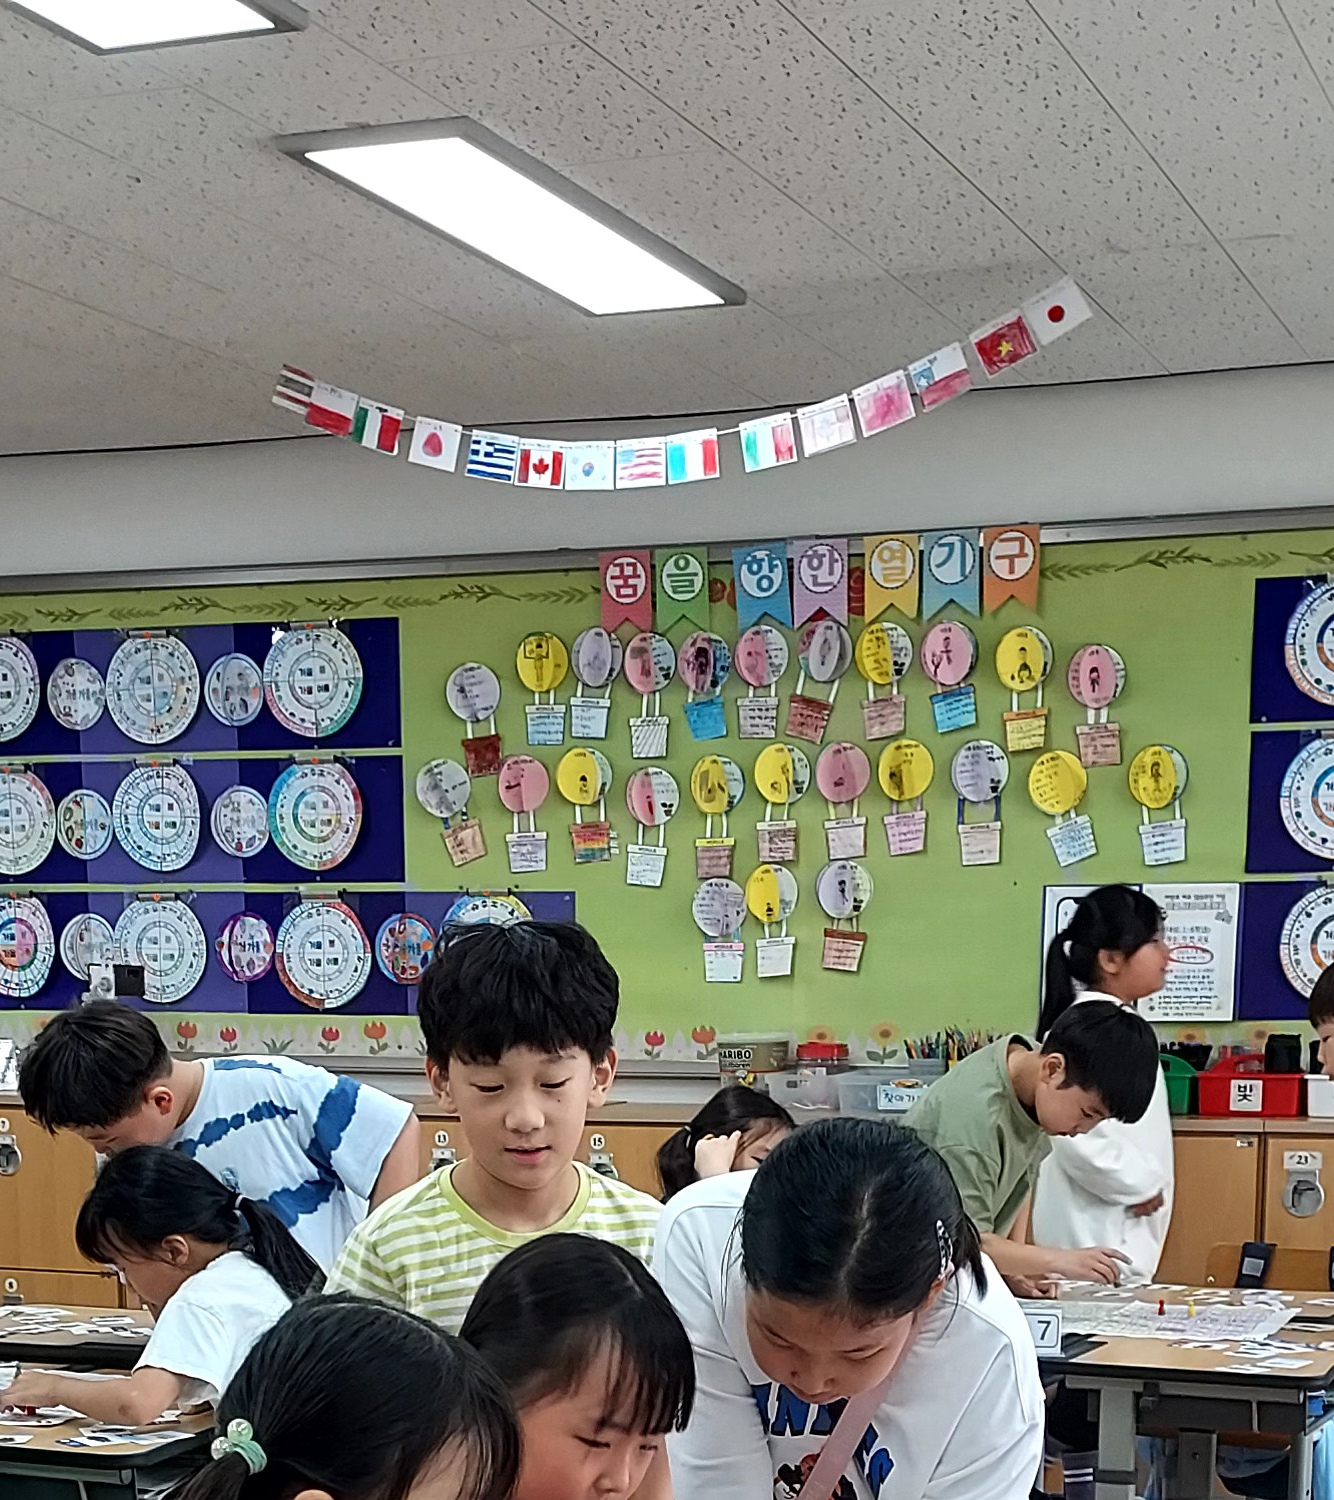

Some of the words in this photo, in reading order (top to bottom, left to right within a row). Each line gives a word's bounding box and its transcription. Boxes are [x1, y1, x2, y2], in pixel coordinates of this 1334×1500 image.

[610, 555, 700, 598] 꿈을
[746, 543, 837, 594] 향한
[878, 535, 1029, 586] 열기구
[884, 1091, 920, 1104] 찾아가
[1237, 1084, 1253, 1103] 빛
[437, 1134, 447, 1143] 13
[593, 1137, 603, 1147] 15
[1295, 1155, 1309, 1165] 23
[1036, 1319, 1051, 1343] 7
